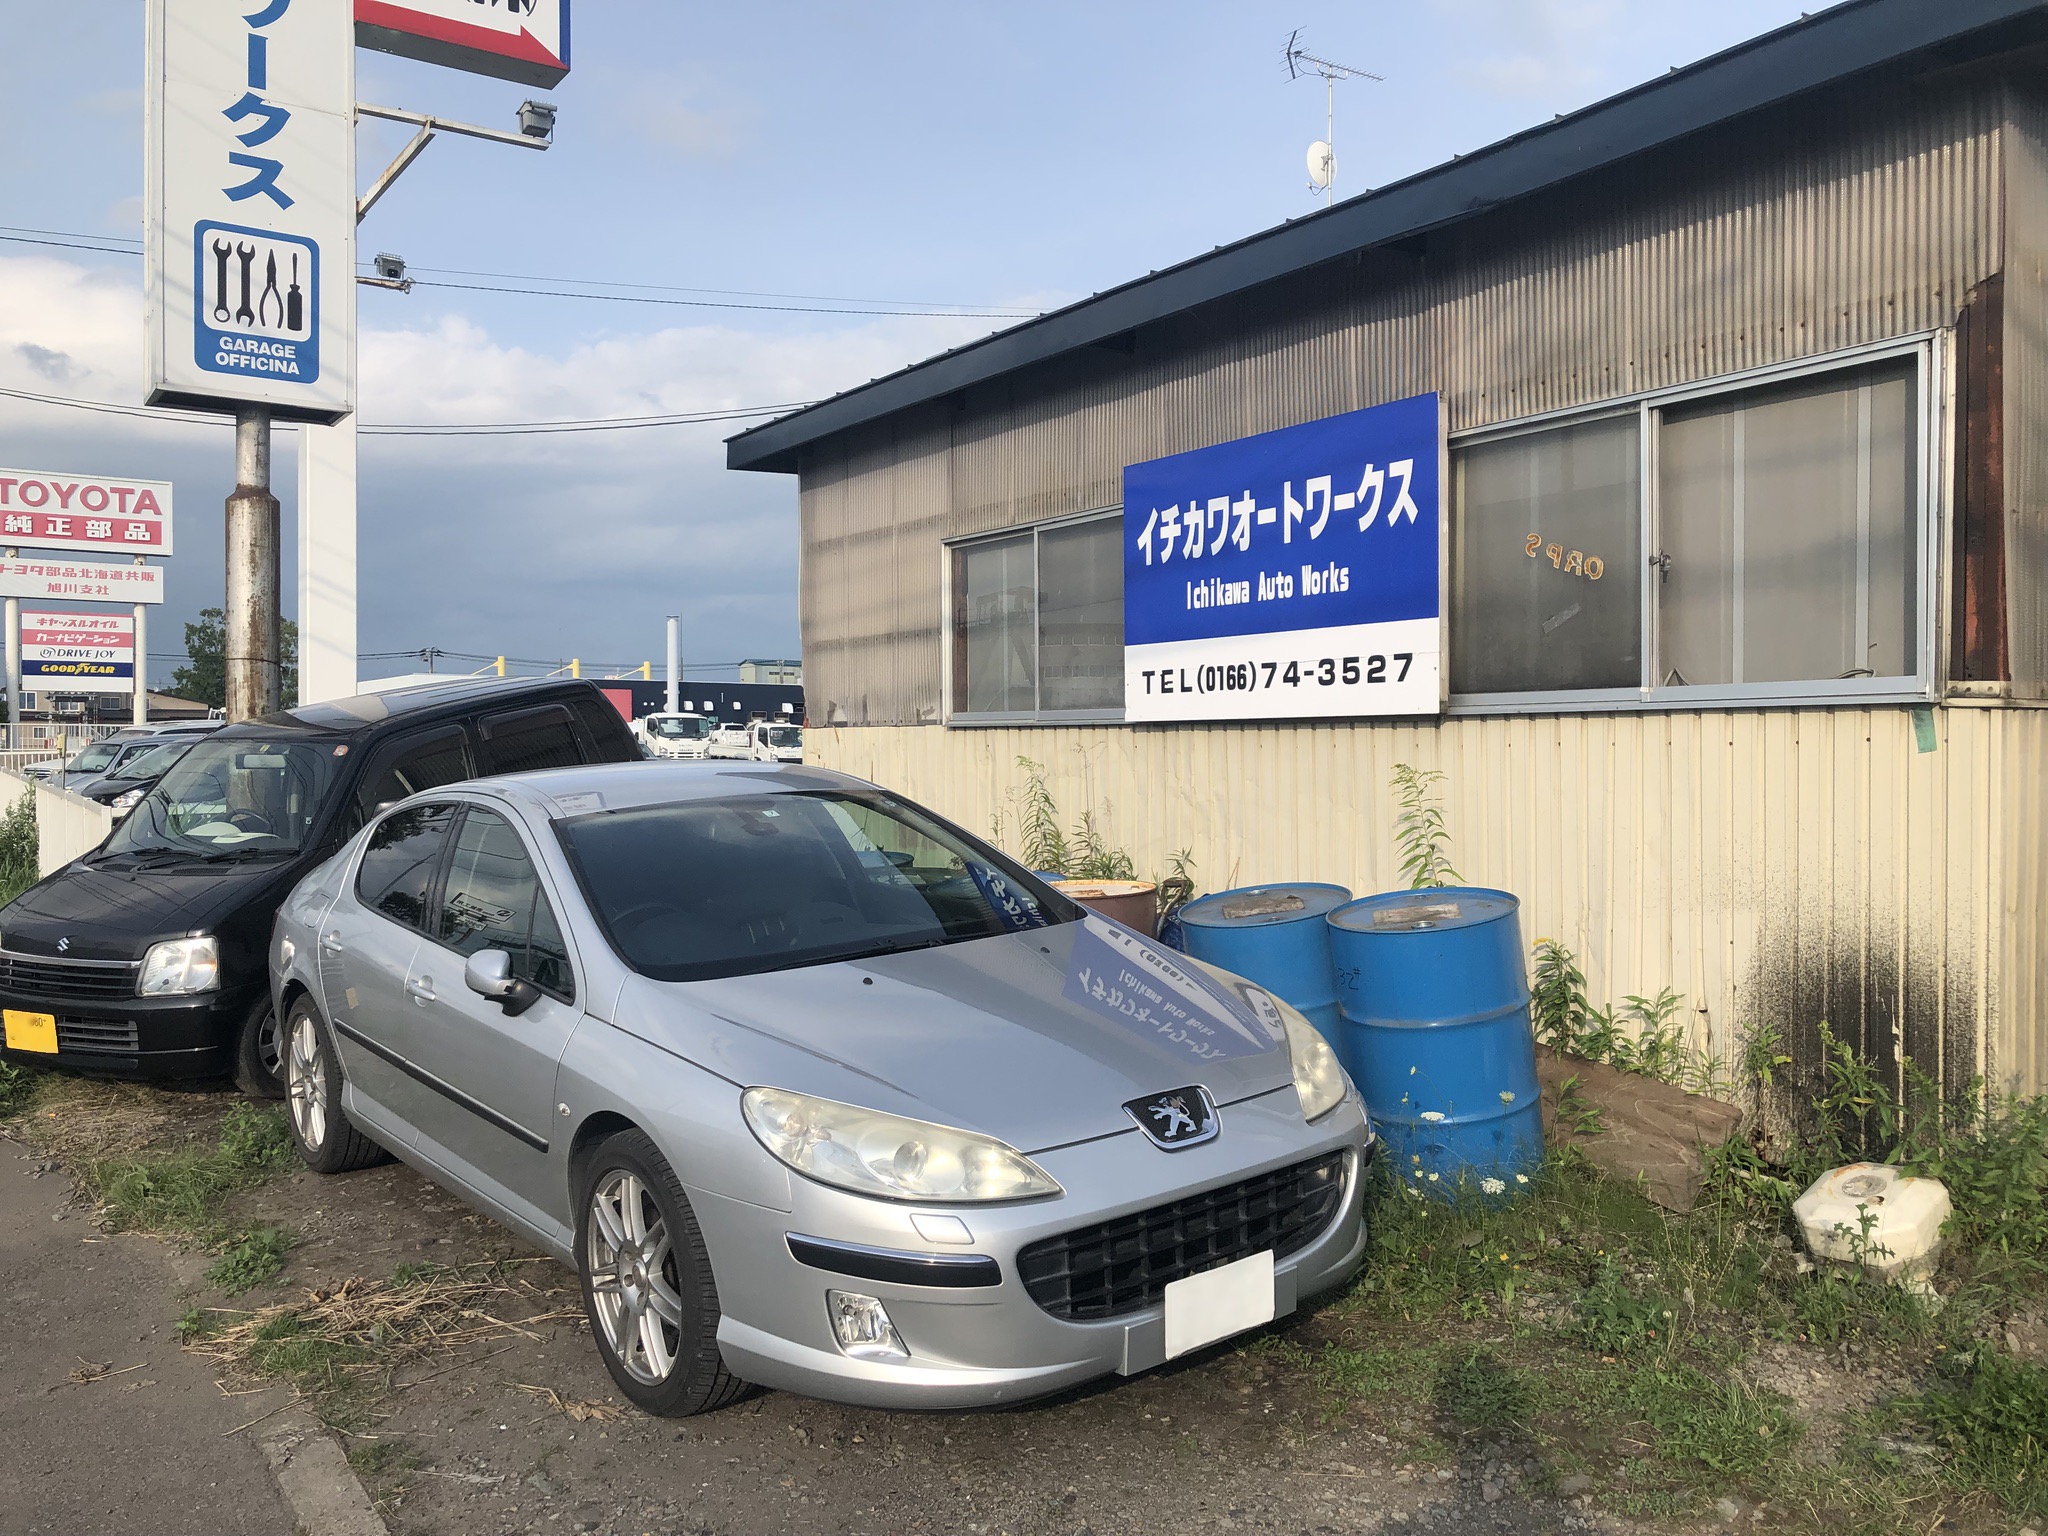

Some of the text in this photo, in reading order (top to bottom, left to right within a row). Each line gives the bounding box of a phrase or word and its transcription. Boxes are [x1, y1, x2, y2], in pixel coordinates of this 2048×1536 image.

[219, 336, 297, 359] GARAGE
[215, 352, 301, 375] OFFICINA
[0, 477, 163, 516] TOYOTA
[1137, 458, 1419, 566] イチカワオートワークス
[4, 514, 151, 541] 純正部品
[47, 582, 110, 596] 旭川支社
[1186, 561, 1350, 610] Ichikawa Auto Works
[36, 633, 120, 645] カーナビゲーション
[57, 648, 93, 658] DRIVE
[94, 649, 117, 659] JOY
[40, 662, 116, 676] GOODYEAR
